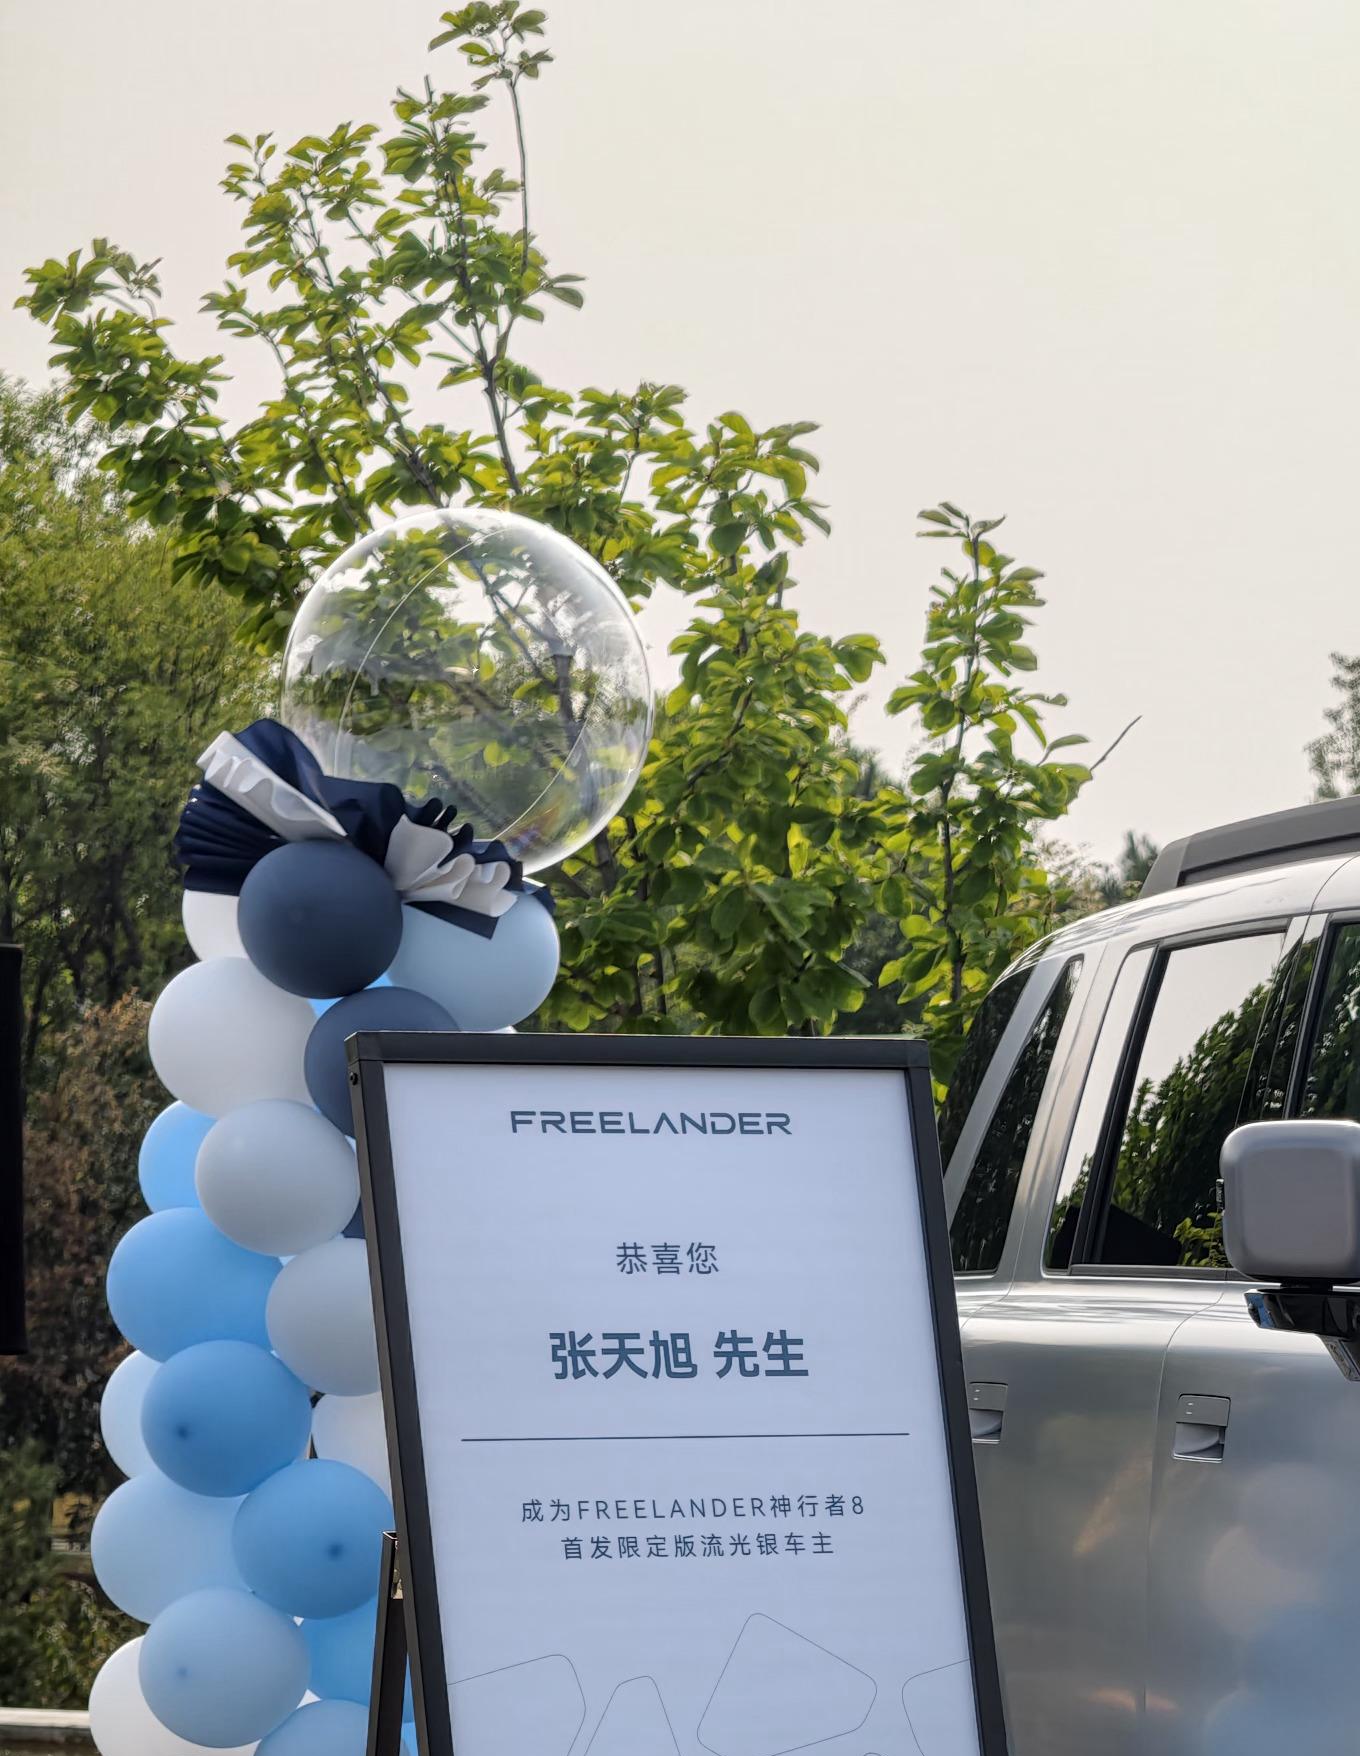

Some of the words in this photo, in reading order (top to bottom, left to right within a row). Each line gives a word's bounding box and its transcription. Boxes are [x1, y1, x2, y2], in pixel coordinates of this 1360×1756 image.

[510, 1110, 793, 1136] FREELANDER
[615, 1241, 720, 1276] 恭喜您
[548, 1330, 698, 1380] 张天旭
[713, 1329, 809, 1380] 先生
[521, 1493, 865, 1524] 成为FREELANDER神行者8
[560, 1531, 835, 1561] 首发限定版流光银车主
